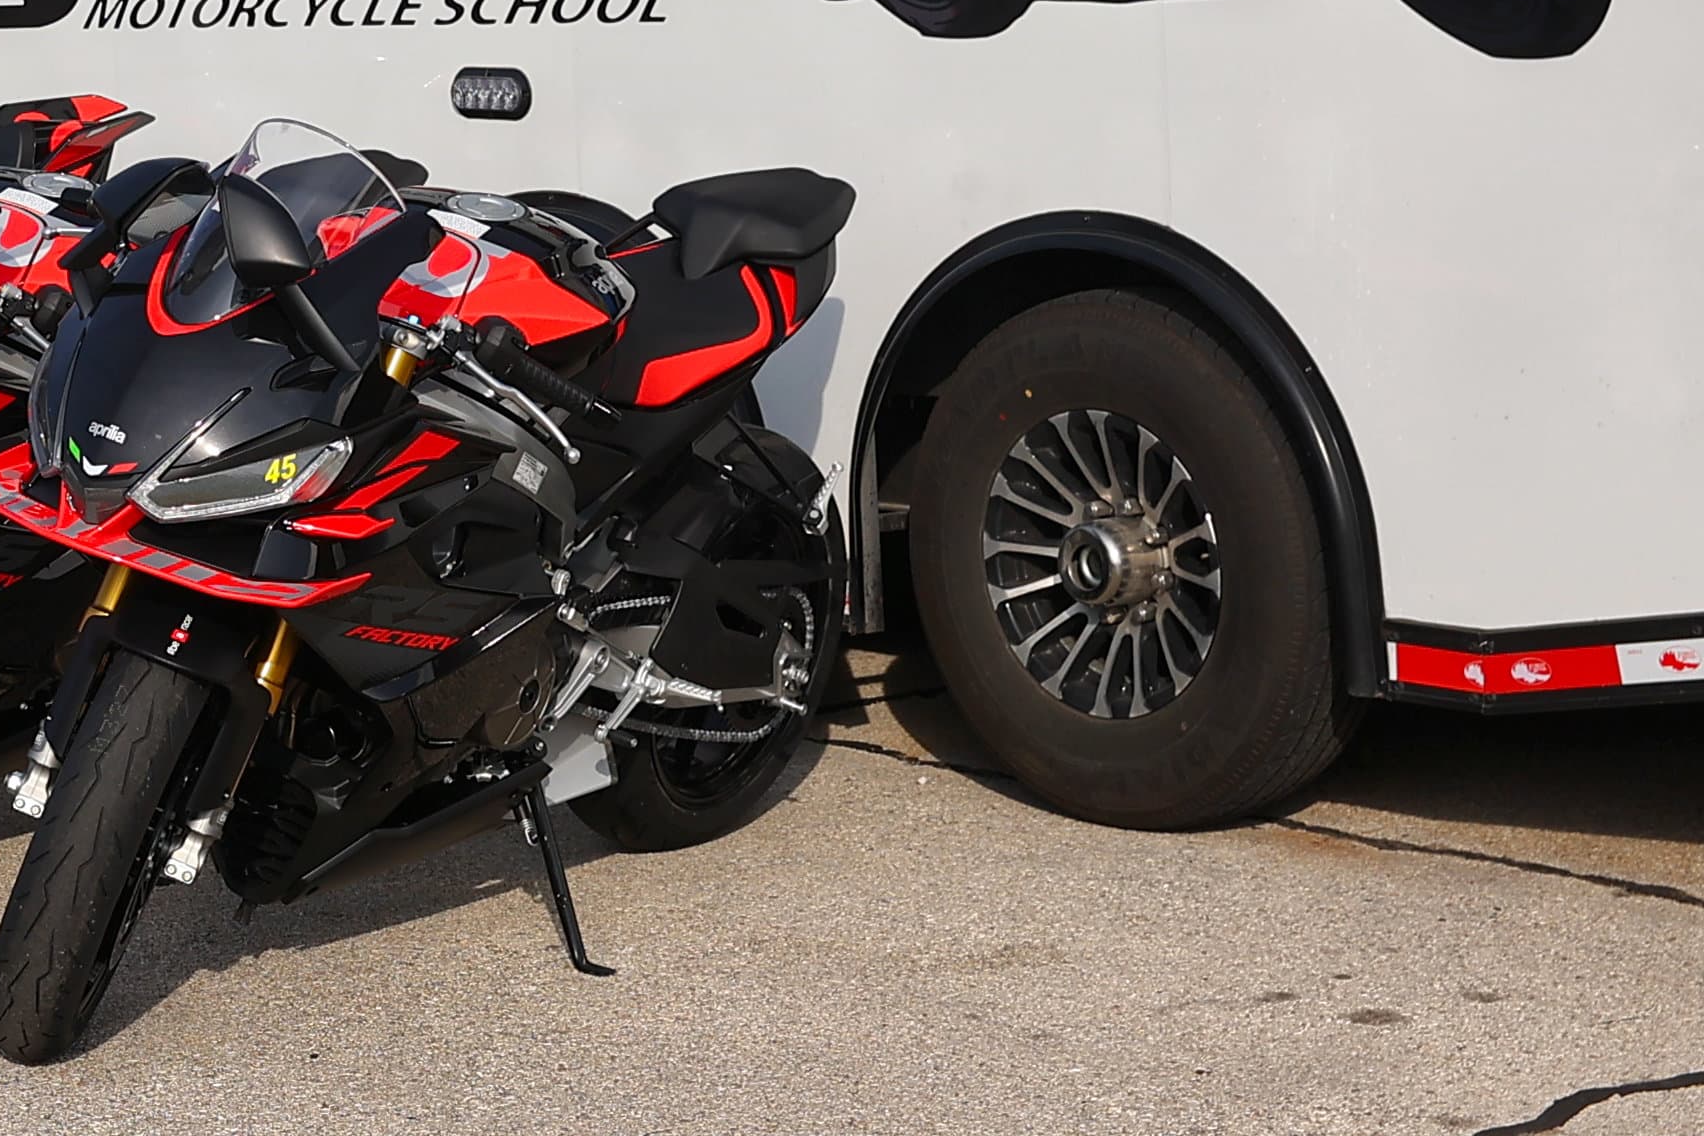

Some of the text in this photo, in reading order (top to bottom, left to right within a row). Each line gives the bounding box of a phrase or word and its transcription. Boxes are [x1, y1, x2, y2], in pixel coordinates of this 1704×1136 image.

[88, 421, 127, 445] aprilia
[264, 453, 297, 484] 45
[344, 624, 462, 652] FACTORY
